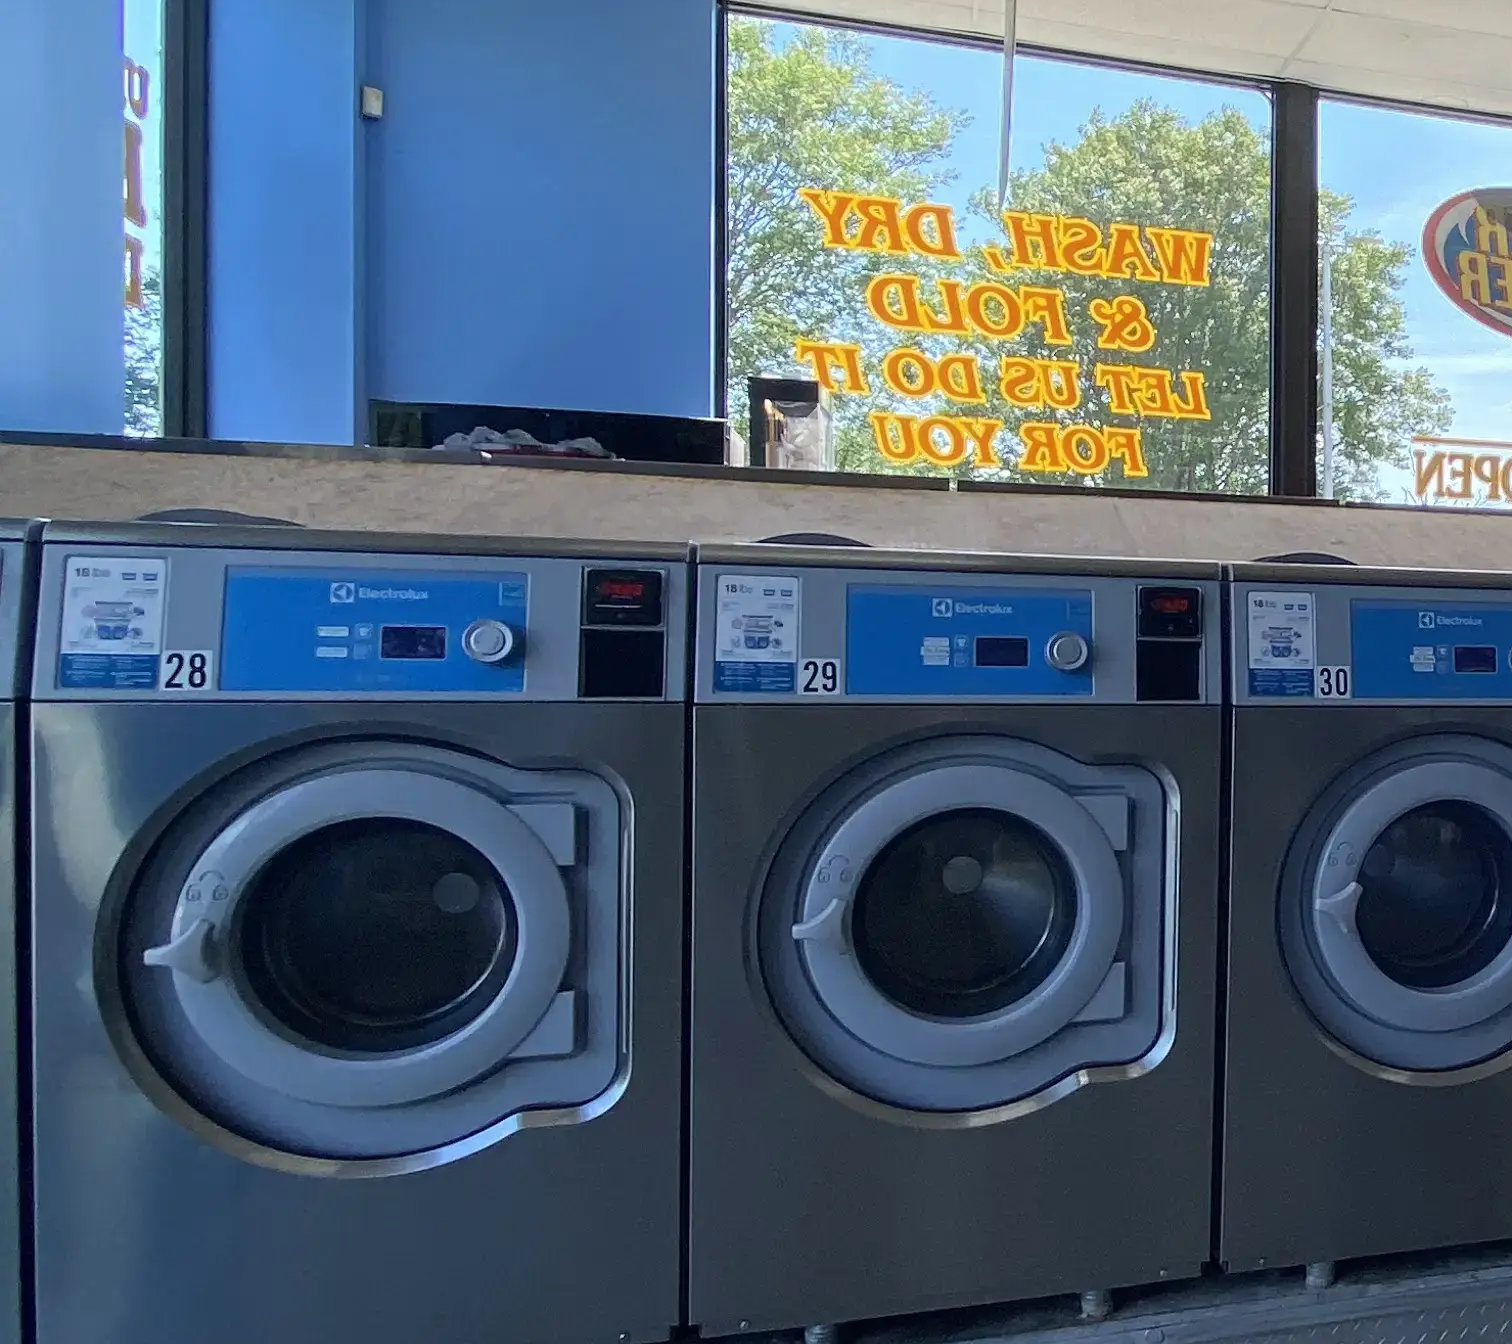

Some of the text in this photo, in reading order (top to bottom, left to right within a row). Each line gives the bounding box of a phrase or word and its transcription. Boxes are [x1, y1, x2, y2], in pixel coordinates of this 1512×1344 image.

[358, 586, 429, 600] Electrolux
[954, 602, 1013, 614] Electrolux
[1436, 615, 1483, 627] Electrolux
[164, 652, 207, 689] 28
[803, 661, 837, 692] 29
[1319, 667, 1348, 696] 30
